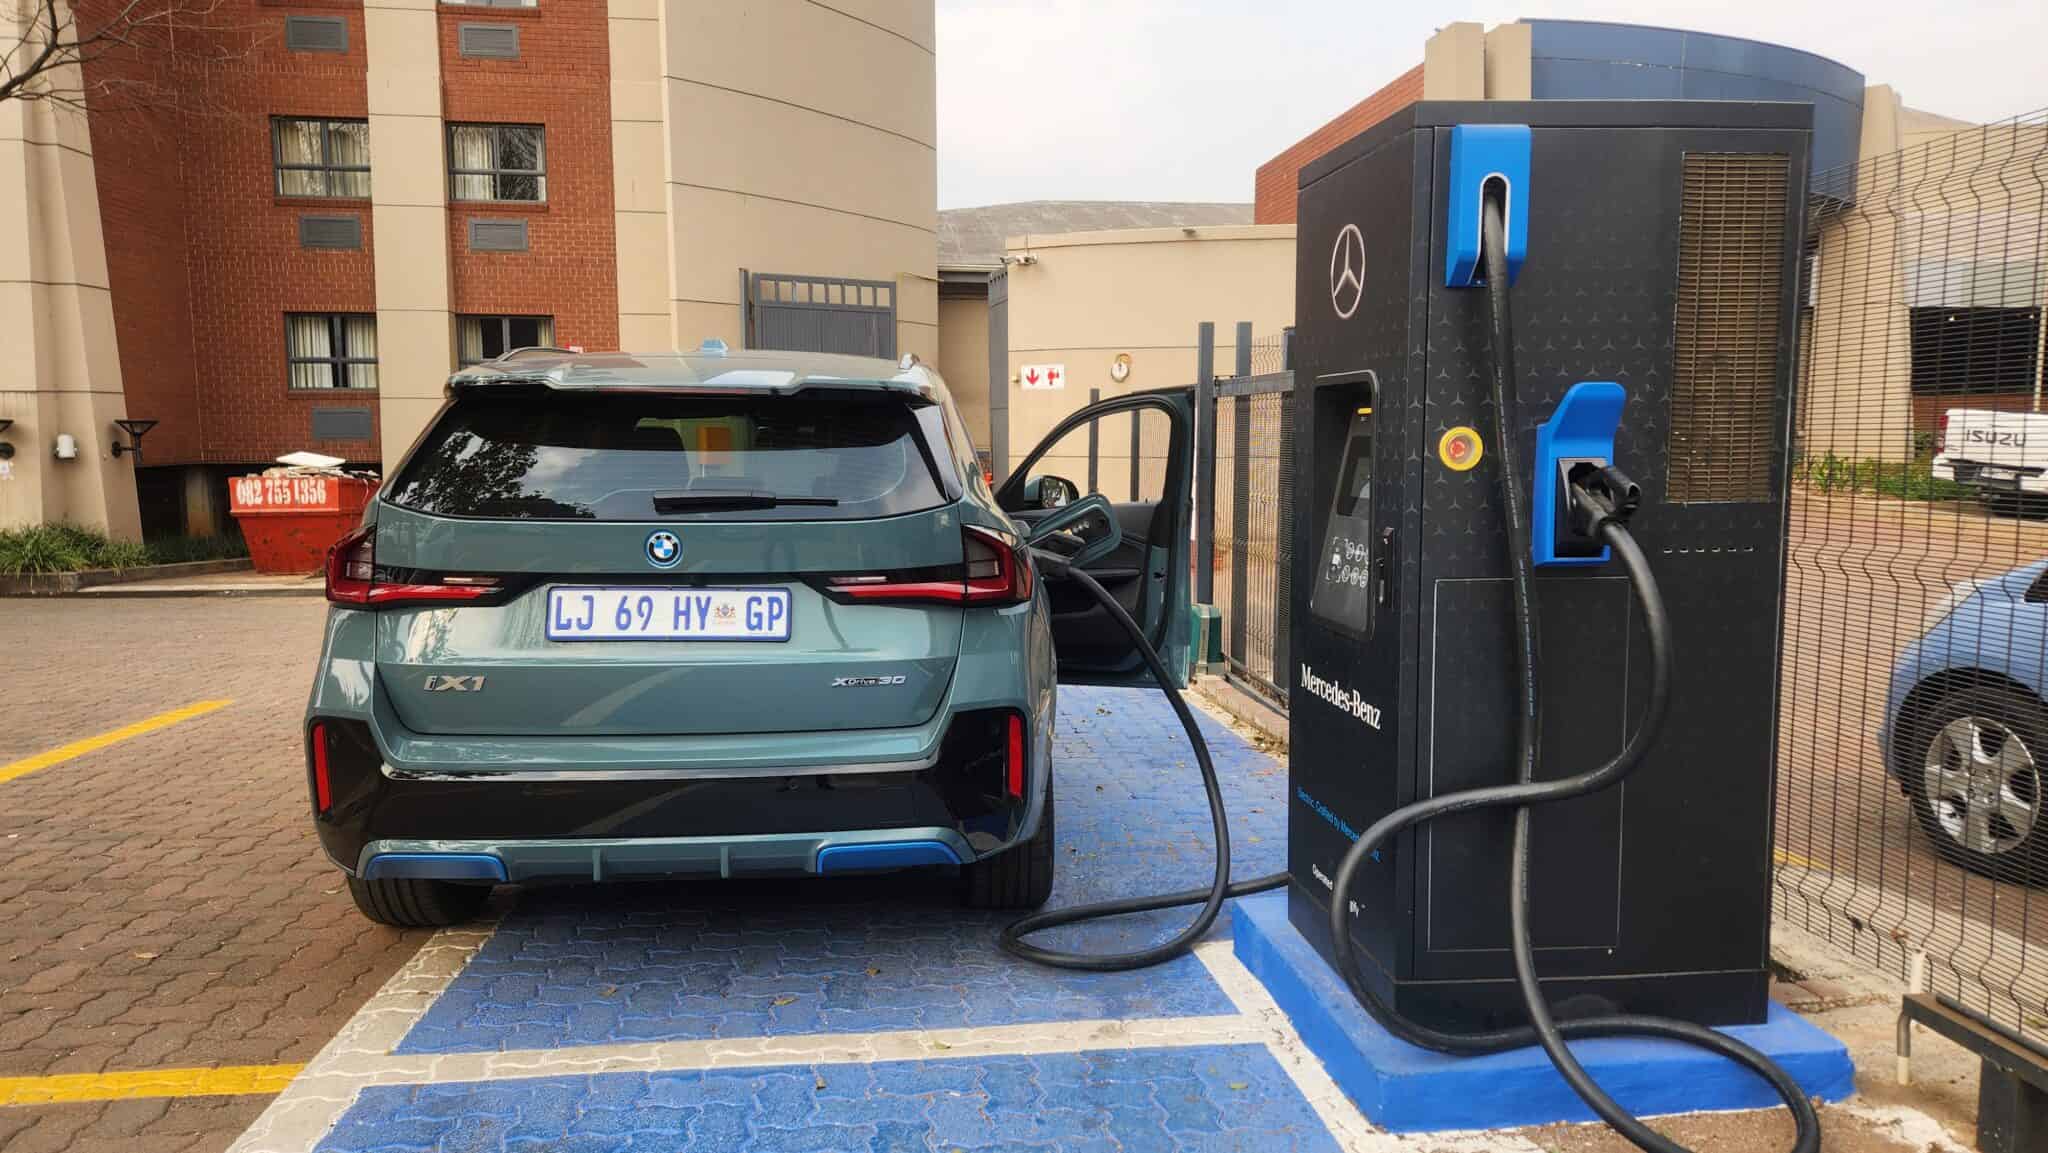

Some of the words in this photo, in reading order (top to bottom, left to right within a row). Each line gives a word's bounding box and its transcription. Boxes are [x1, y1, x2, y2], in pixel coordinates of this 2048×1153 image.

[1966, 429, 2026, 447] ISUZU
[237, 479, 263, 505] 082
[266, 479, 291, 504] 755
[295, 480, 326, 504] 1356
[555, 595, 594, 631] LJ
[615, 595, 654, 631] 69
[673, 595, 711, 631] HY
[745, 596, 784, 631] GP
[424, 675, 486, 691] iX1
[1301, 662, 1381, 730] Mercedes-Benz
